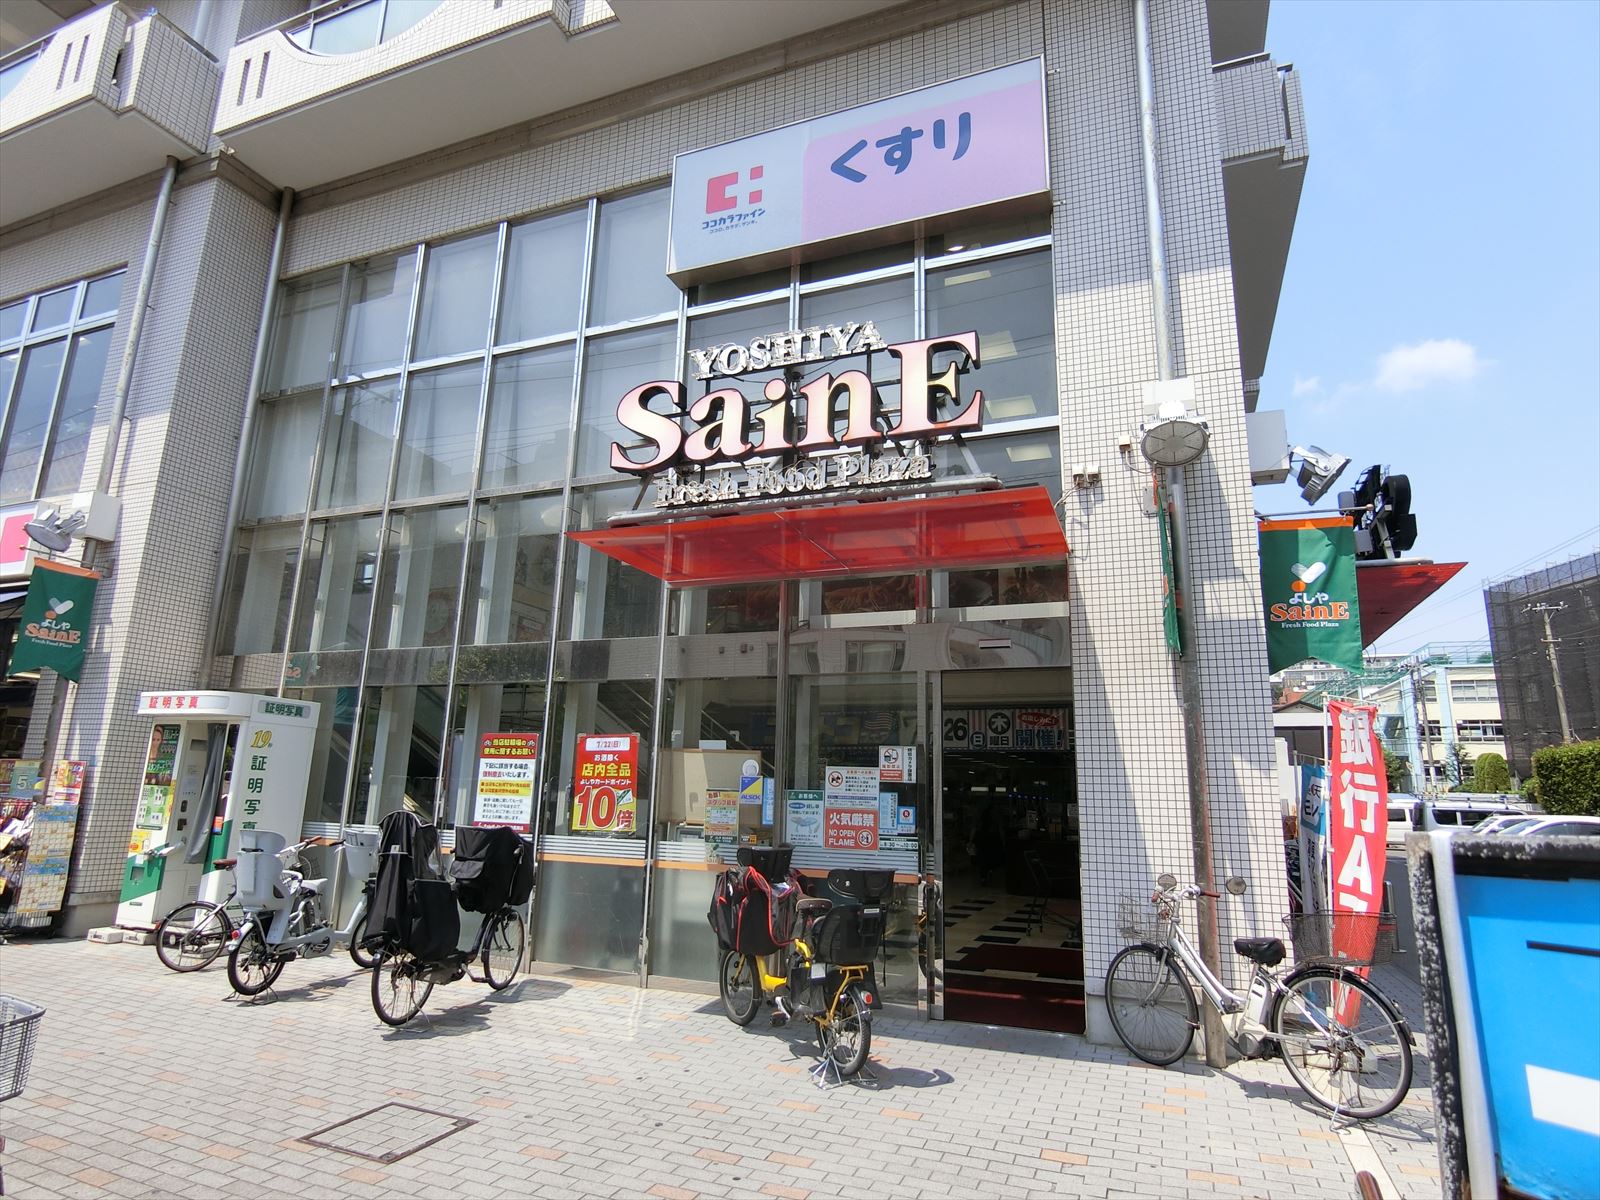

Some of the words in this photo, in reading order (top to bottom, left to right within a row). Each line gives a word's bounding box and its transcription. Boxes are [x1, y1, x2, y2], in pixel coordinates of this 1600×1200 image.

[830, 112, 971, 183] くすり
[702, 208, 766, 230] ココカラファイン
[687, 320, 888, 379] YOSHIYA
[610, 330, 985, 474] SainE
[651, 470, 740, 508] Fresh
[746, 458, 830, 497] Food
[834, 452, 933, 487] Plaza
[1289, 592, 1329, 604] よしや
[1270, 601, 1350, 622] SainE
[40, 619, 71, 631] よしや
[25, 623, 81, 644] SainE
[147, 695, 200, 709] 証明写真
[265, 702, 304, 717] 証明写真
[944, 718, 967, 742] 26
[251, 730, 273, 749] 19
[594, 754, 619, 762] お酒除く
[581, 763, 631, 777] 店内全品
[580, 778, 632, 786] よしやカードポイント
[829, 812, 874, 827] 火気厳禁
[840, 829, 856, 837] OPEN
[828, 838, 855, 846] FLAME
